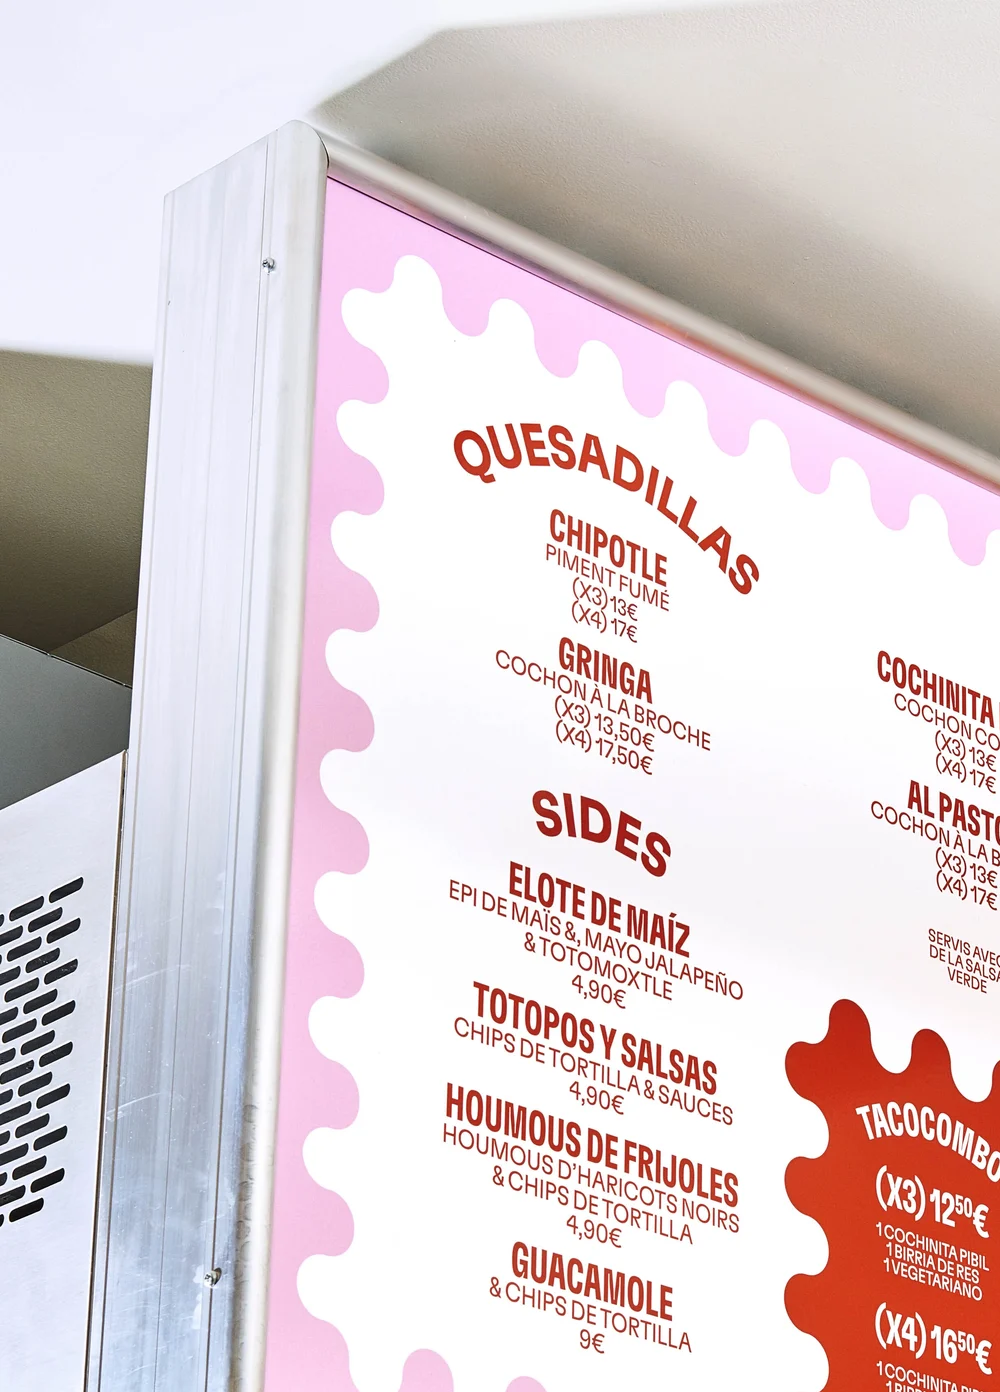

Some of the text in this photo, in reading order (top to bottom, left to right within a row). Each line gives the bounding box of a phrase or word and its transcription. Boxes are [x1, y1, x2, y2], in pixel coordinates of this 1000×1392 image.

[453, 423, 760, 595] QUESADILLAS
[546, 543, 670, 612] PIMENT FUMÉ
[550, 509, 667, 587] CHIPOTLE
[496, 650, 711, 751] COCHON À LA BROCHE
[558, 637, 653, 704] GRINGA
[877, 650, 995, 728] COCHINITA
[555, 695, 655, 752] (X3) 13,50€
[556, 720, 653, 775] (X4) 17,50€
[894, 693, 972, 740] COCHON
[908, 779, 935, 819] AL
[532, 790, 671, 877] SIDES
[936, 847, 998, 889] (X3) 13€
[936, 870, 997, 911] (X4) 17€
[510, 860, 690, 958] ELOTE DE MAÍZ
[928, 928, 971, 956] SERVIS
[524, 932, 673, 1001] & TOTOMOXTLE
[930, 944, 946, 963] DE
[948, 951, 964, 969] LA
[948, 966, 987, 994] VERDE
[572, 974, 626, 1009] 4,90€
[473, 981, 718, 1095] TOTOPOS Y SALSAS
[443, 1122, 553, 1175] HOUMOUS
[682, 1198, 740, 1233] NOIRS
[446, 1082, 738, 1207] HOUMOUS DE FRIJOLES
[876, 1222, 989, 1271] 1 COCHINITA PIBIL
[512, 1241, 673, 1321] GUACAMOLE
[579, 1329, 605, 1354] 9€
